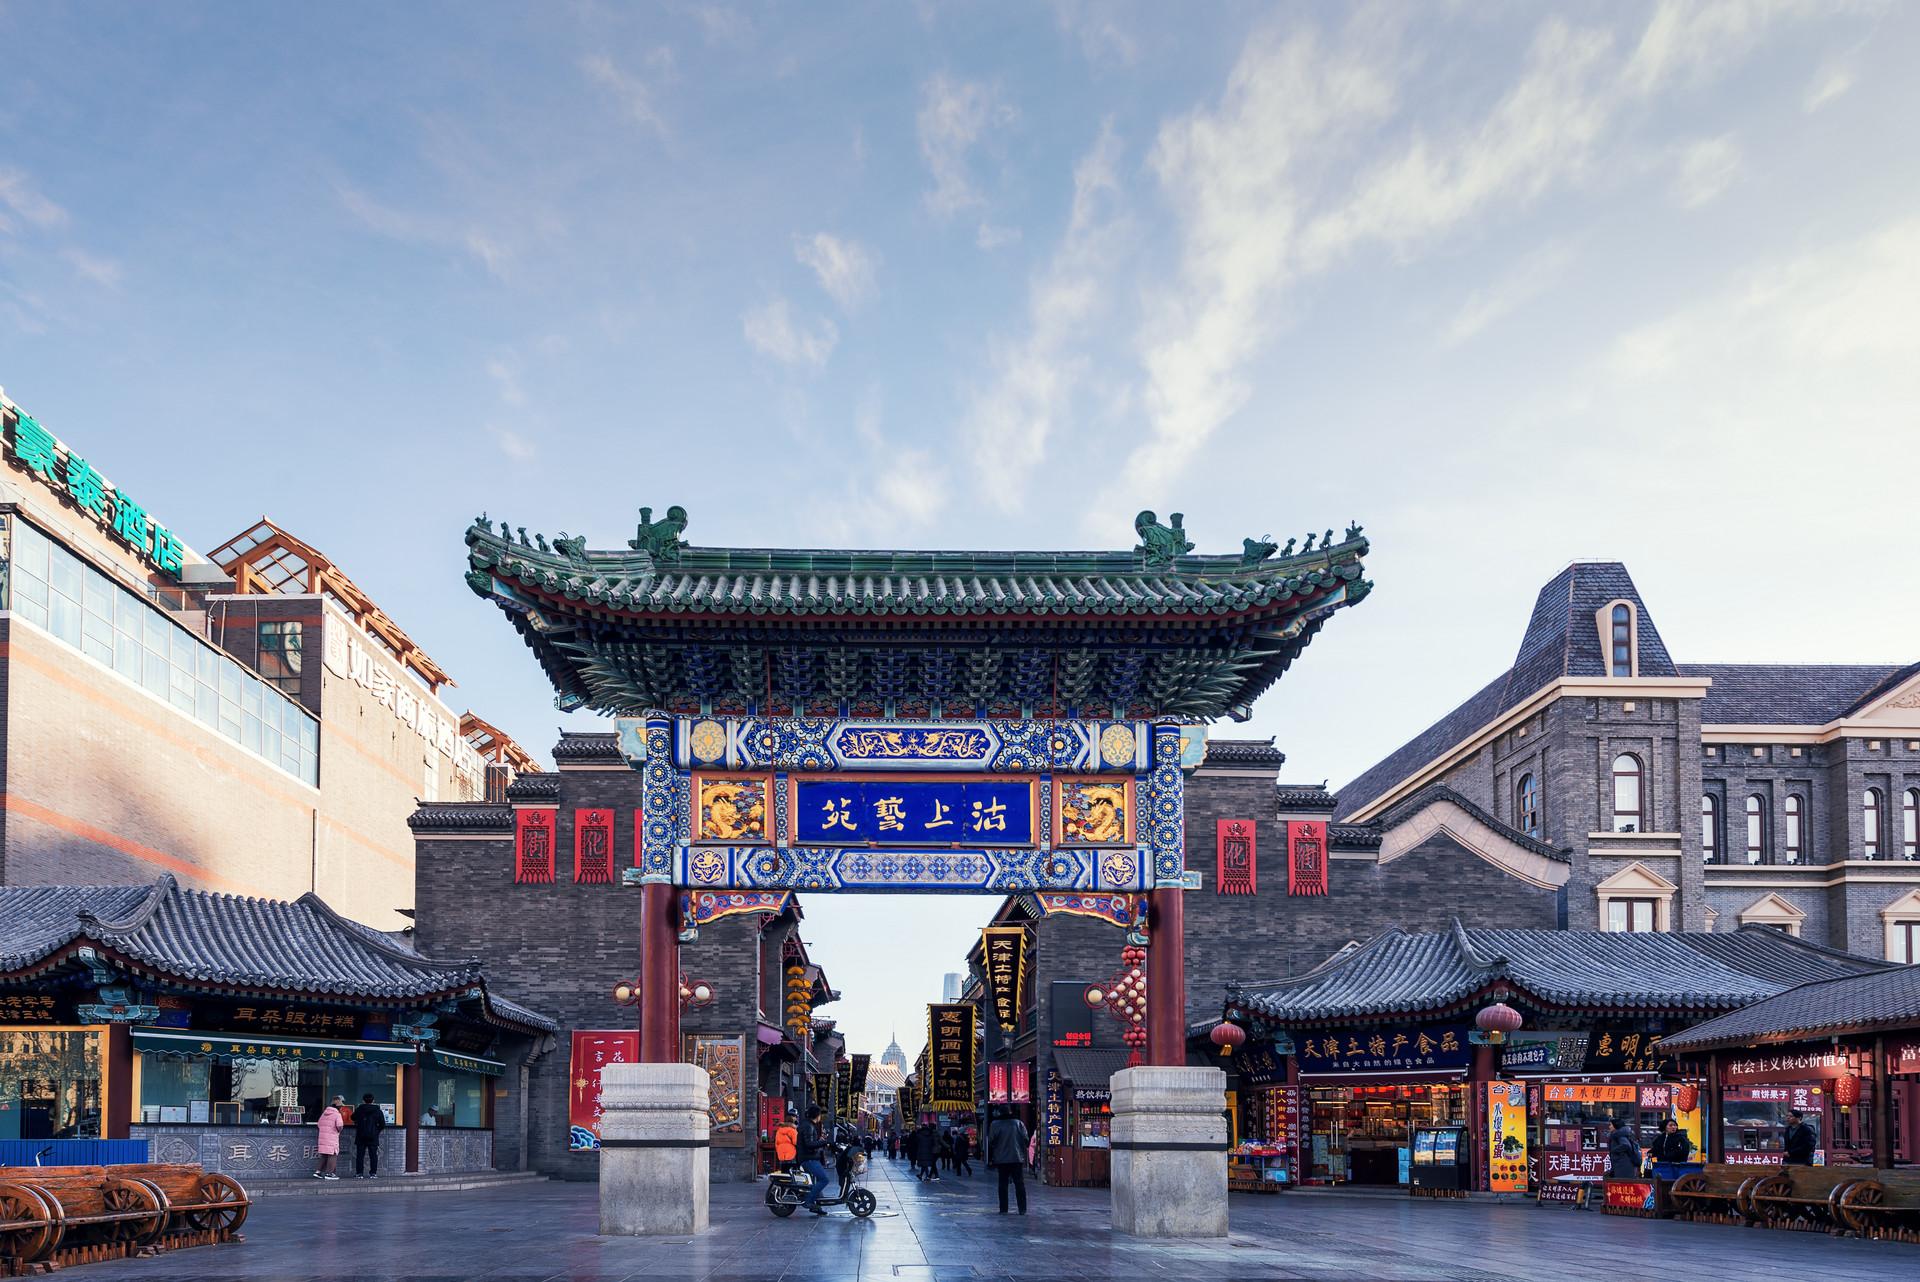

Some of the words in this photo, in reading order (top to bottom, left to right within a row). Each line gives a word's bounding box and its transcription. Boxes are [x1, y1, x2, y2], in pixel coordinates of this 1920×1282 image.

[0, 401, 184, 581] 豪泰酒店
[348, 638, 472, 773] 如家商旅酒店
[0, 995, 56, 1009] 老字号
[233, 1007, 356, 1029] 耳朵眼炸糕
[230, 1044, 303, 1057] 耳朵眼炸糕
[319, 1049, 366, 1060] 天津三绝
[1304, 1031, 1459, 1061] 天津土特产食品
[1901, 1044, 1920, 1061] 富
[1549, 1086, 1632, 1100] 台湾水爆鸟蛋
[1641, 1087, 1668, 1106] 热饮
[1752, 1089, 1788, 1100] 煎饼果子
[1047, 1071, 1062, 1145] 天津土特产食品
[228, 1144, 321, 1162] 耳朵眼
